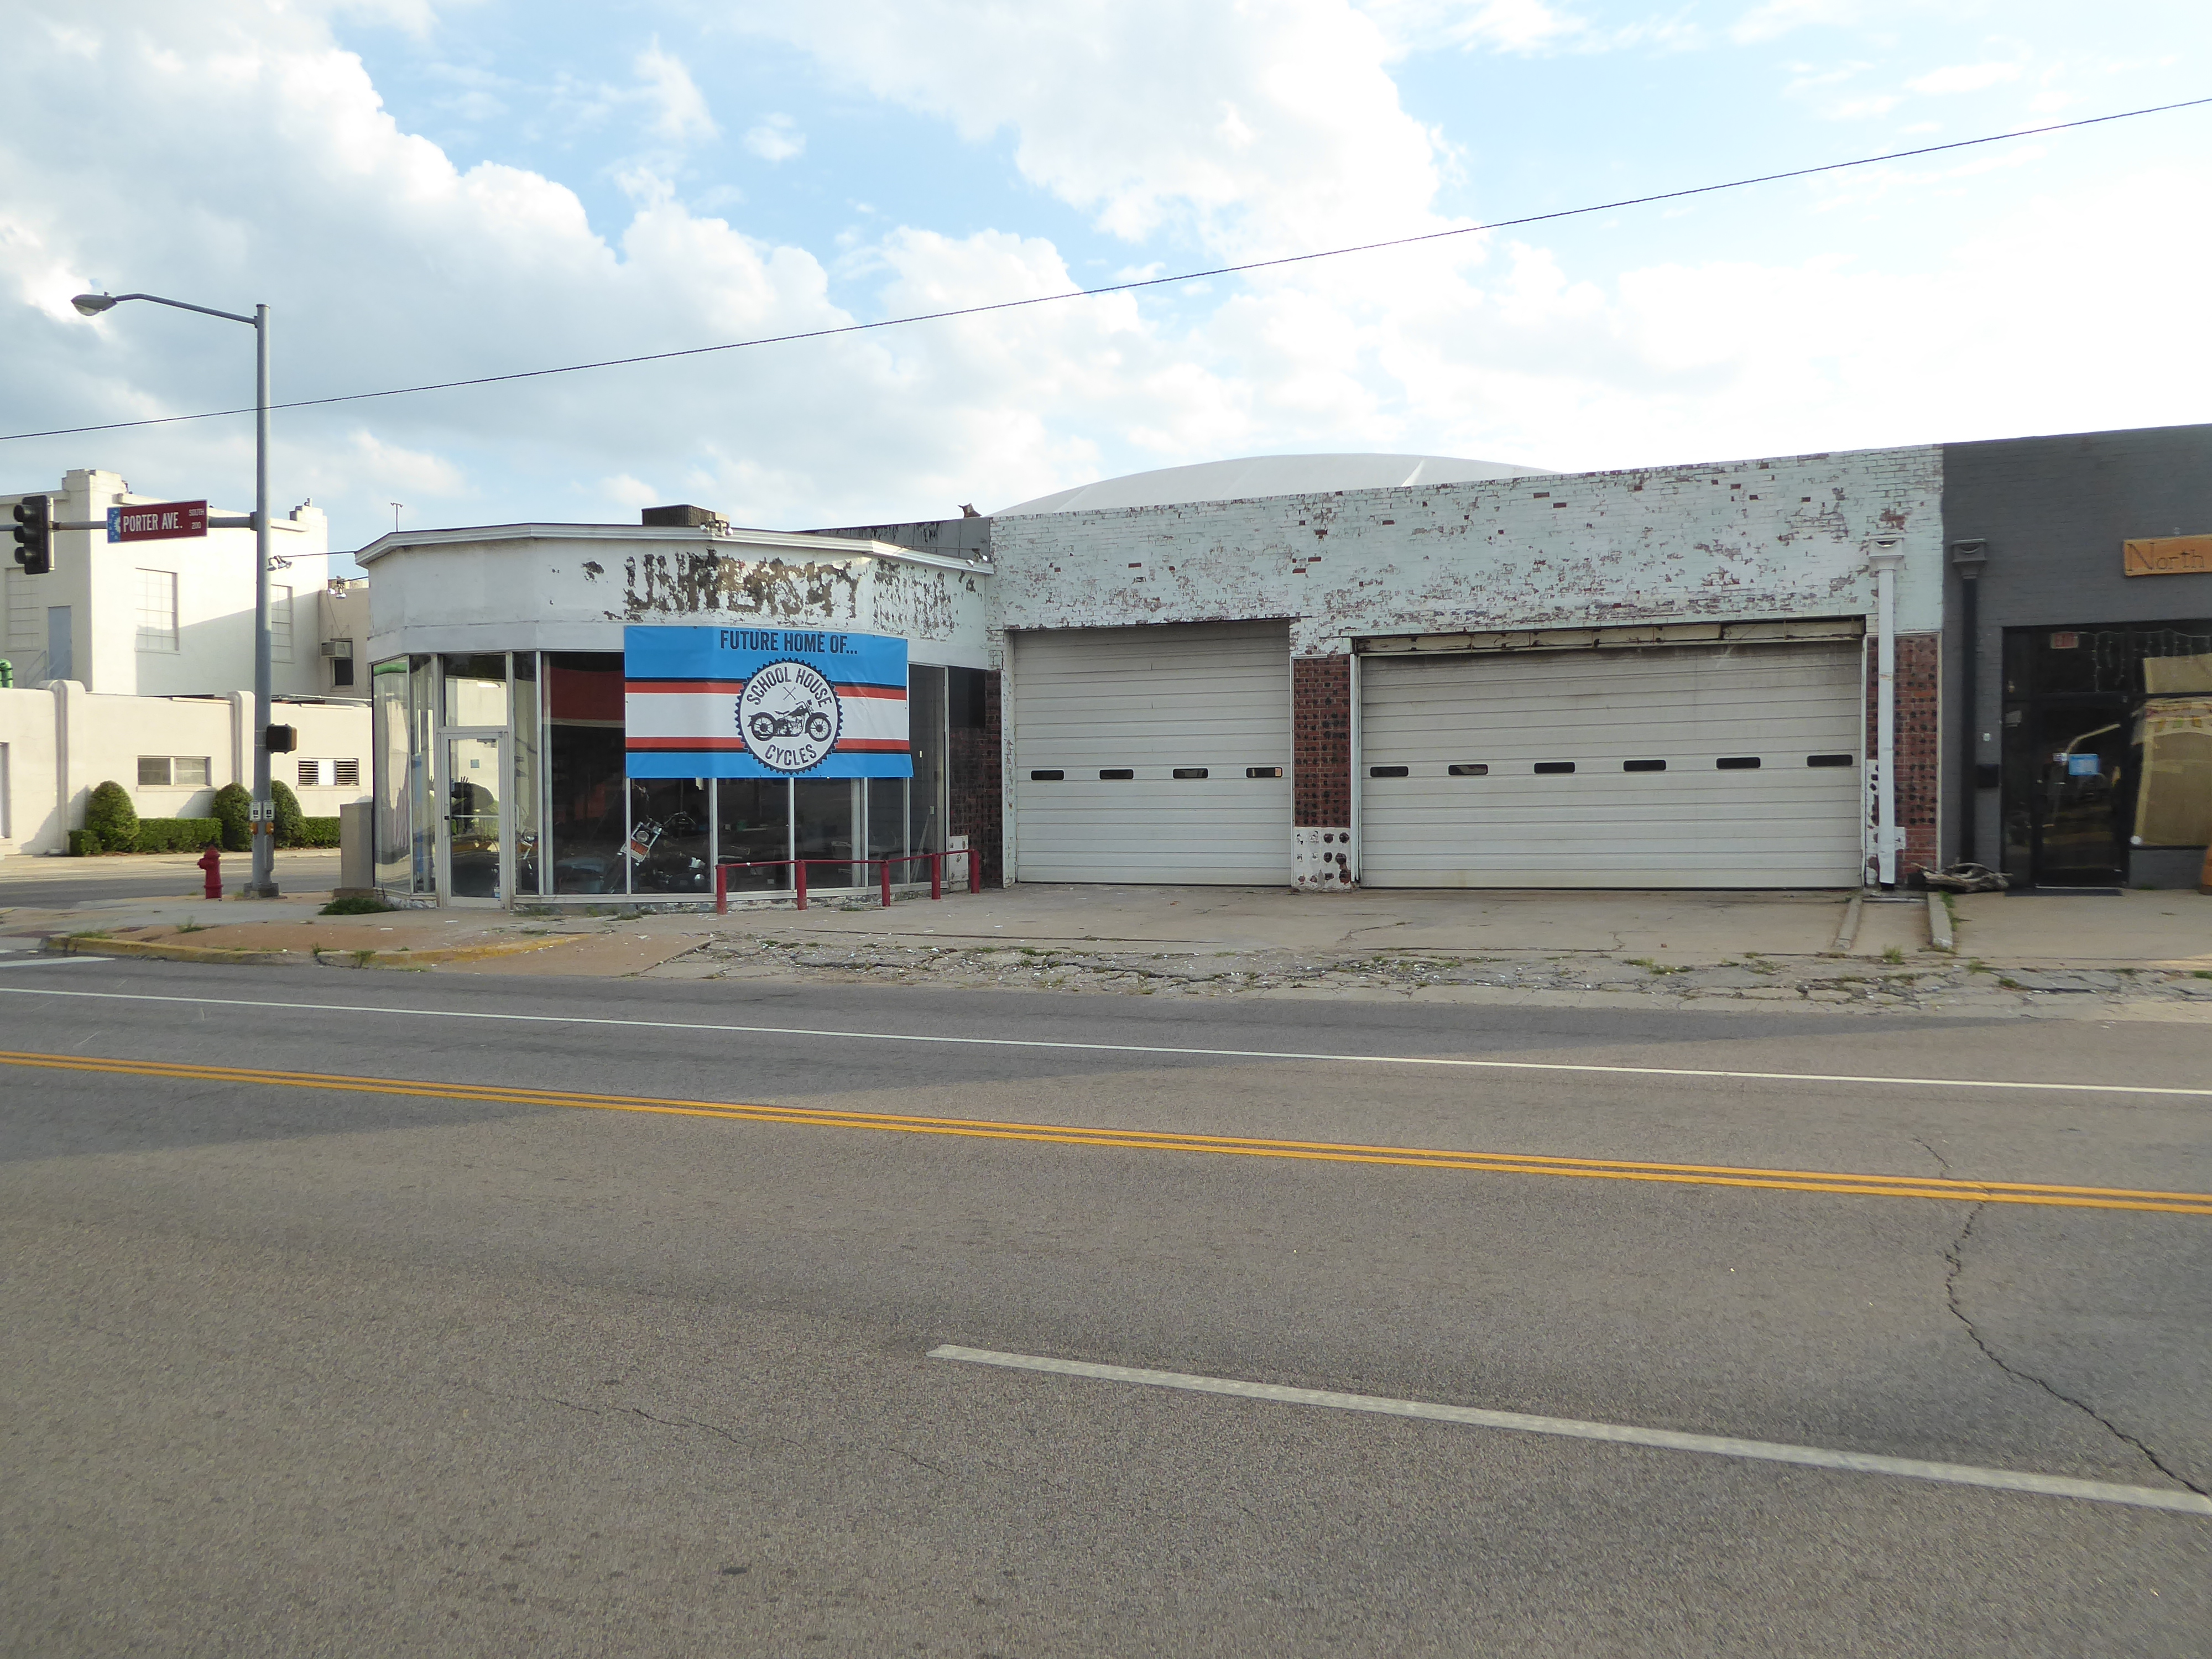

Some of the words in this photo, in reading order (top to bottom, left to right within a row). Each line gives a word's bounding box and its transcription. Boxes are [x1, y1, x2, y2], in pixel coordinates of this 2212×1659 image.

[123, 514, 158, 533] PORTER
[161, 512, 183, 530] AVE.
[2127, 542, 2204, 571] North
[721, 630, 779, 651] FUTURE
[784, 632, 825, 653] HOME
[830, 635, 858, 654] OF...
[747, 666, 792, 706] SCHOOL
[795, 667, 832, 708] HOUSE
[765, 744, 817, 766] CYCLES
